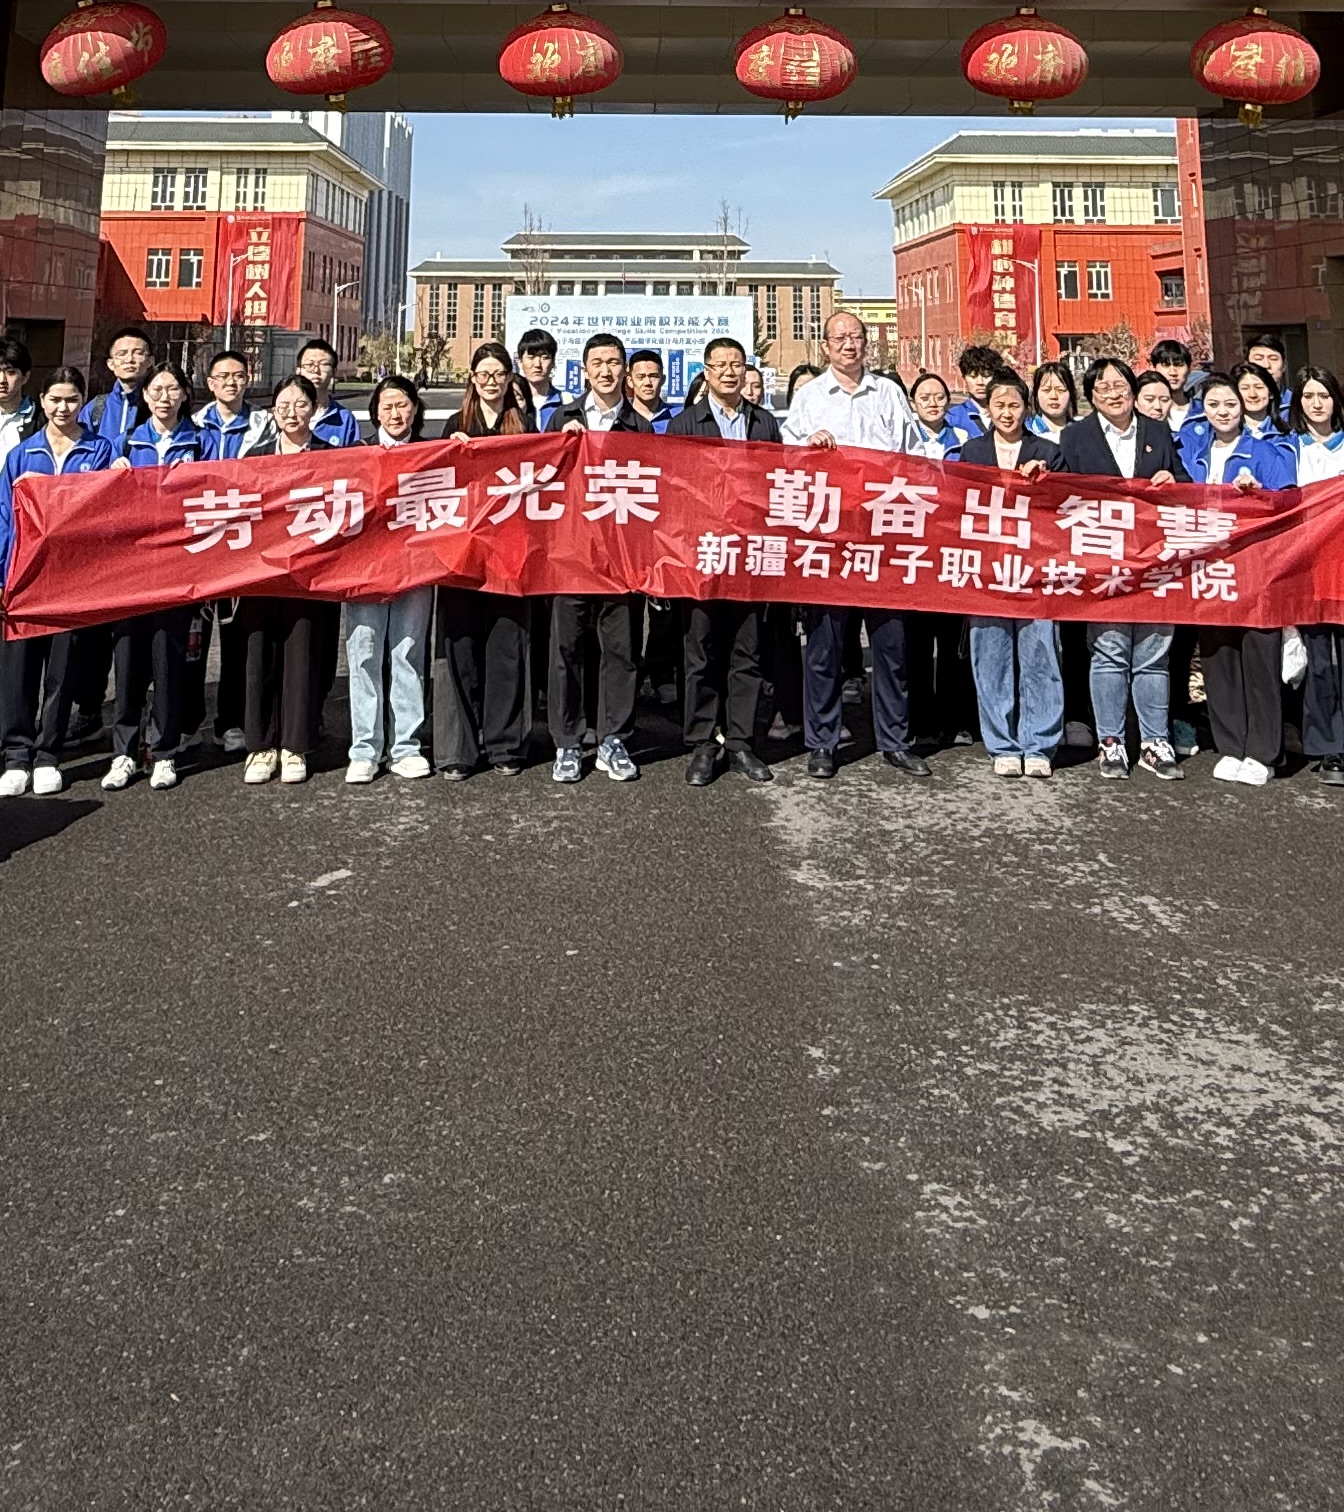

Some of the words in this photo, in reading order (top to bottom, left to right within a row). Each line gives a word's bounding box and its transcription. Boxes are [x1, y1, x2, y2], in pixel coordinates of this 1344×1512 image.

[182, 459, 661, 554] 劳动最光荣
[765, 468, 1238, 561] 勤奋出智慧
[696, 530, 1239, 602] 新疆石河子职业技术学院
